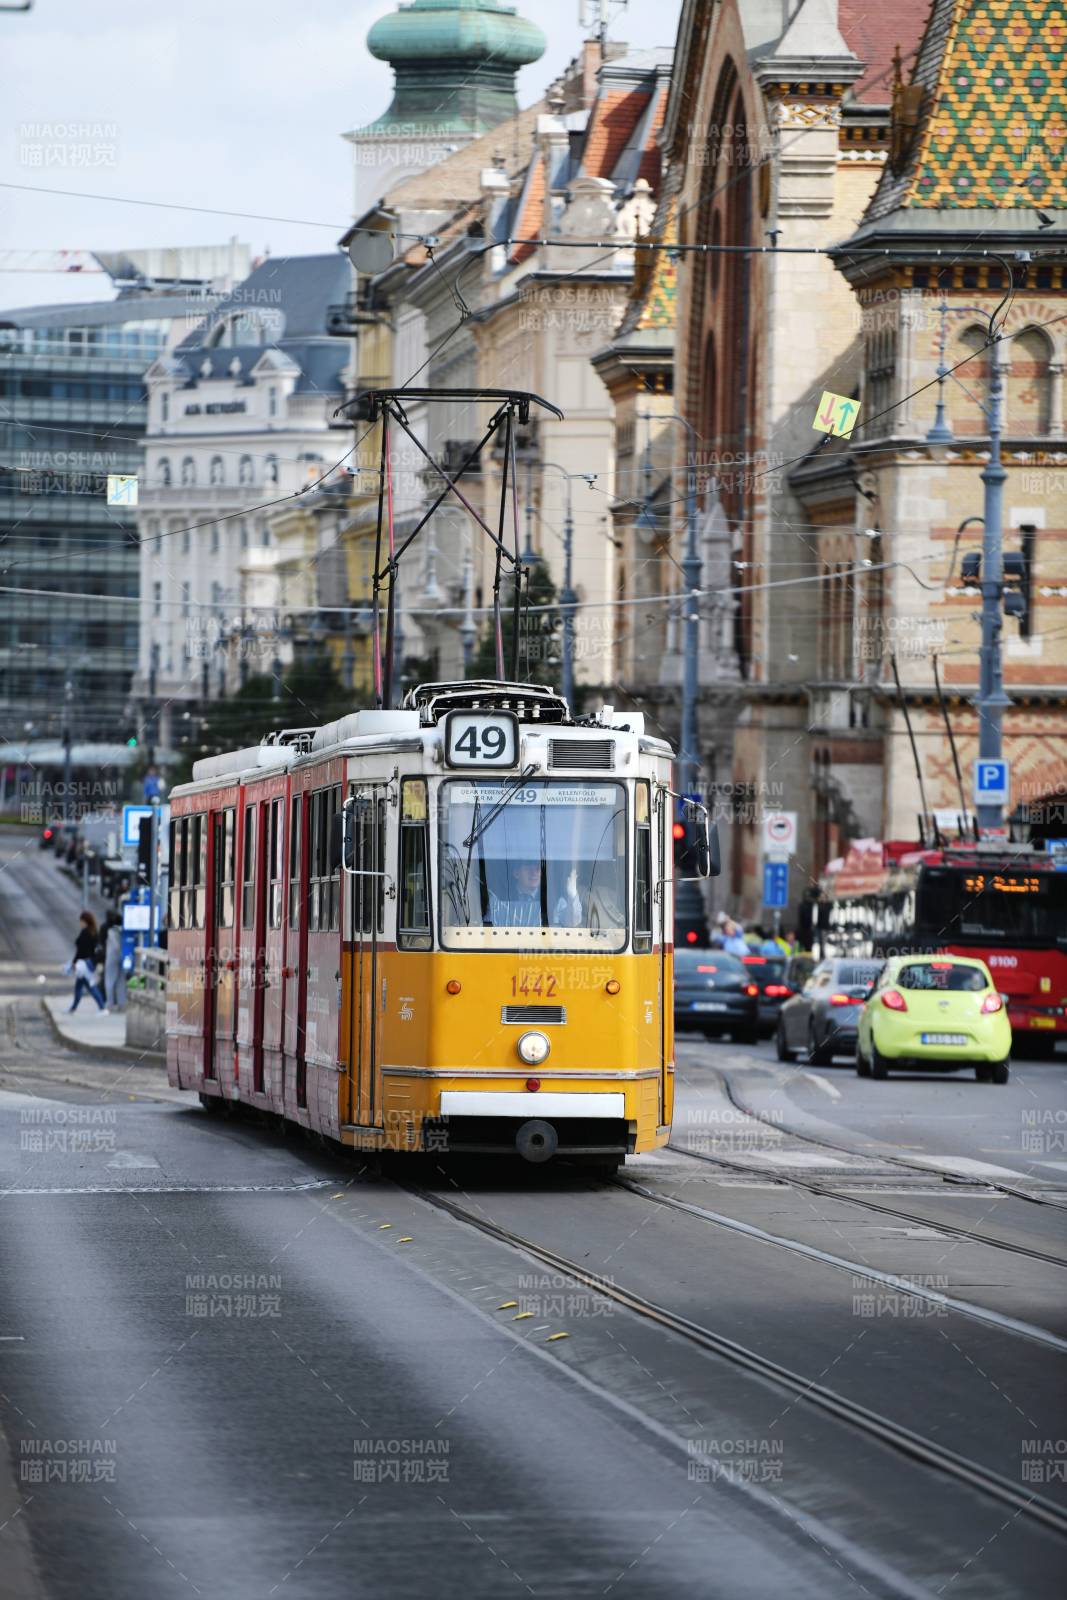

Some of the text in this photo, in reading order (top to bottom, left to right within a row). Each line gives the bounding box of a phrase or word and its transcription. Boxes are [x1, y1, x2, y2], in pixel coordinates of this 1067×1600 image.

[455, 726, 507, 759] 49
[983, 767, 1000, 788] P
[514, 790, 537, 803] 49
[511, 975, 557, 998] 1442
